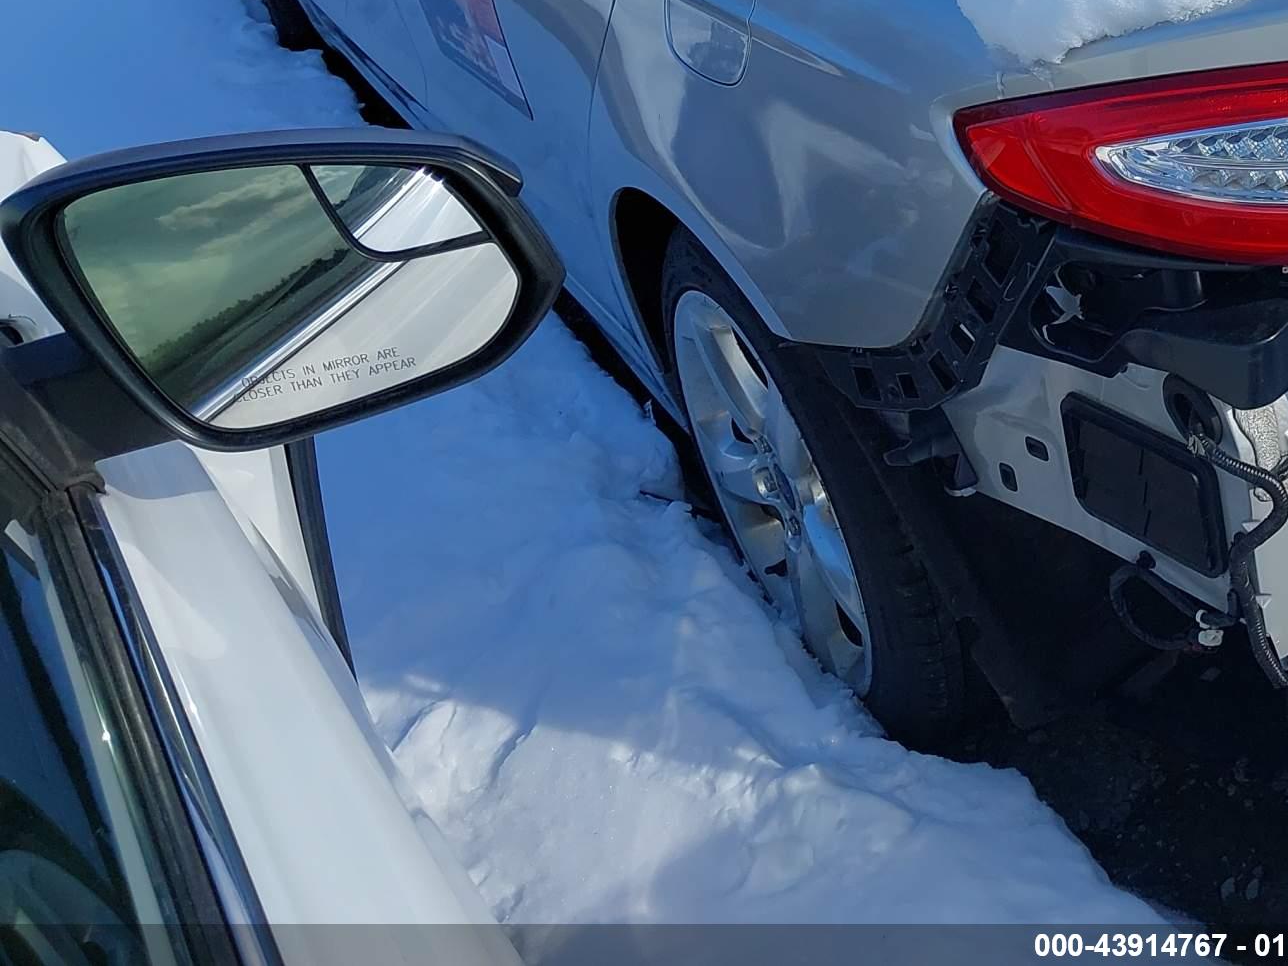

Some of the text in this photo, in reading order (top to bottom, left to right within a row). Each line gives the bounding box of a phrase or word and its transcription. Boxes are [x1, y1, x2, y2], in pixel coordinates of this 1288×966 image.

[290, 377, 322, 392] THAN
[330, 369, 361, 385] THEY
[368, 357, 417, 376] APPEAR
[302, 364, 315, 376] IN
[322, 353, 370, 372] MIRROR
[376, 346, 401, 360] ARE
